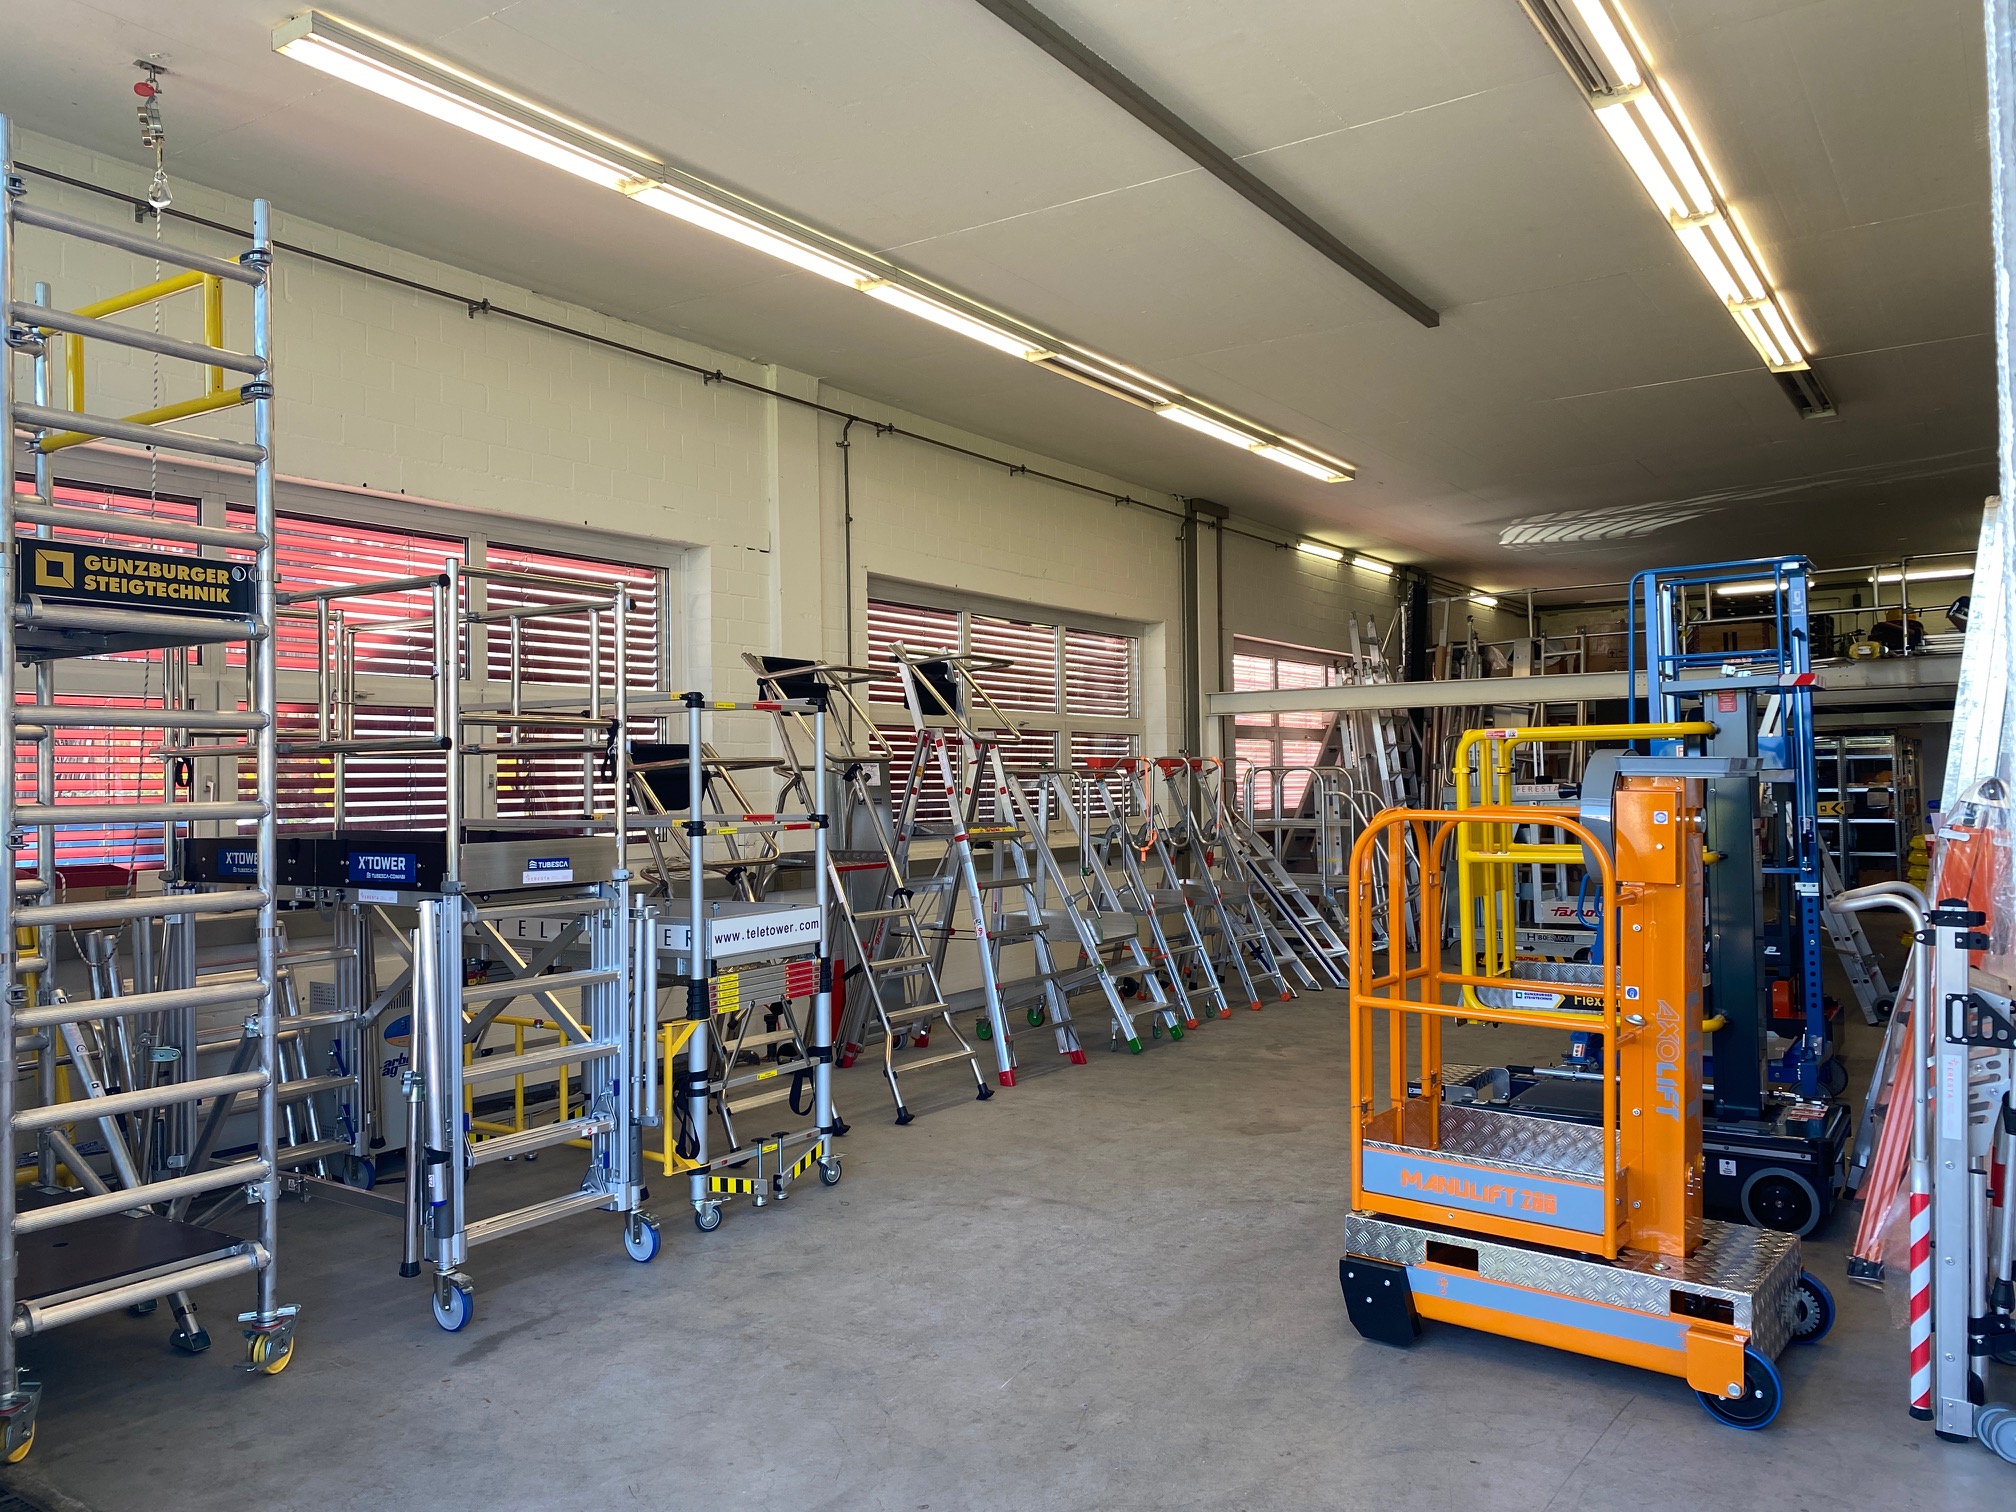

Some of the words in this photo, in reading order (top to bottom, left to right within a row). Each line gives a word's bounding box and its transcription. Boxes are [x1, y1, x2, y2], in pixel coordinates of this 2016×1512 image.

[84, 555, 230, 585] GÜNZBURGER
[84, 575, 230, 603] STEIGTECHNIK
[1516, 785, 1559, 793] FERESTA
[226, 852, 258, 865] X'TOWE
[358, 856, 406, 871] X'TOWER
[714, 919, 819, 944] www.teletower.com
[1655, 1000, 1680, 1122] AXOLIFT
[1401, 1168, 1517, 1207] MANULIFT
